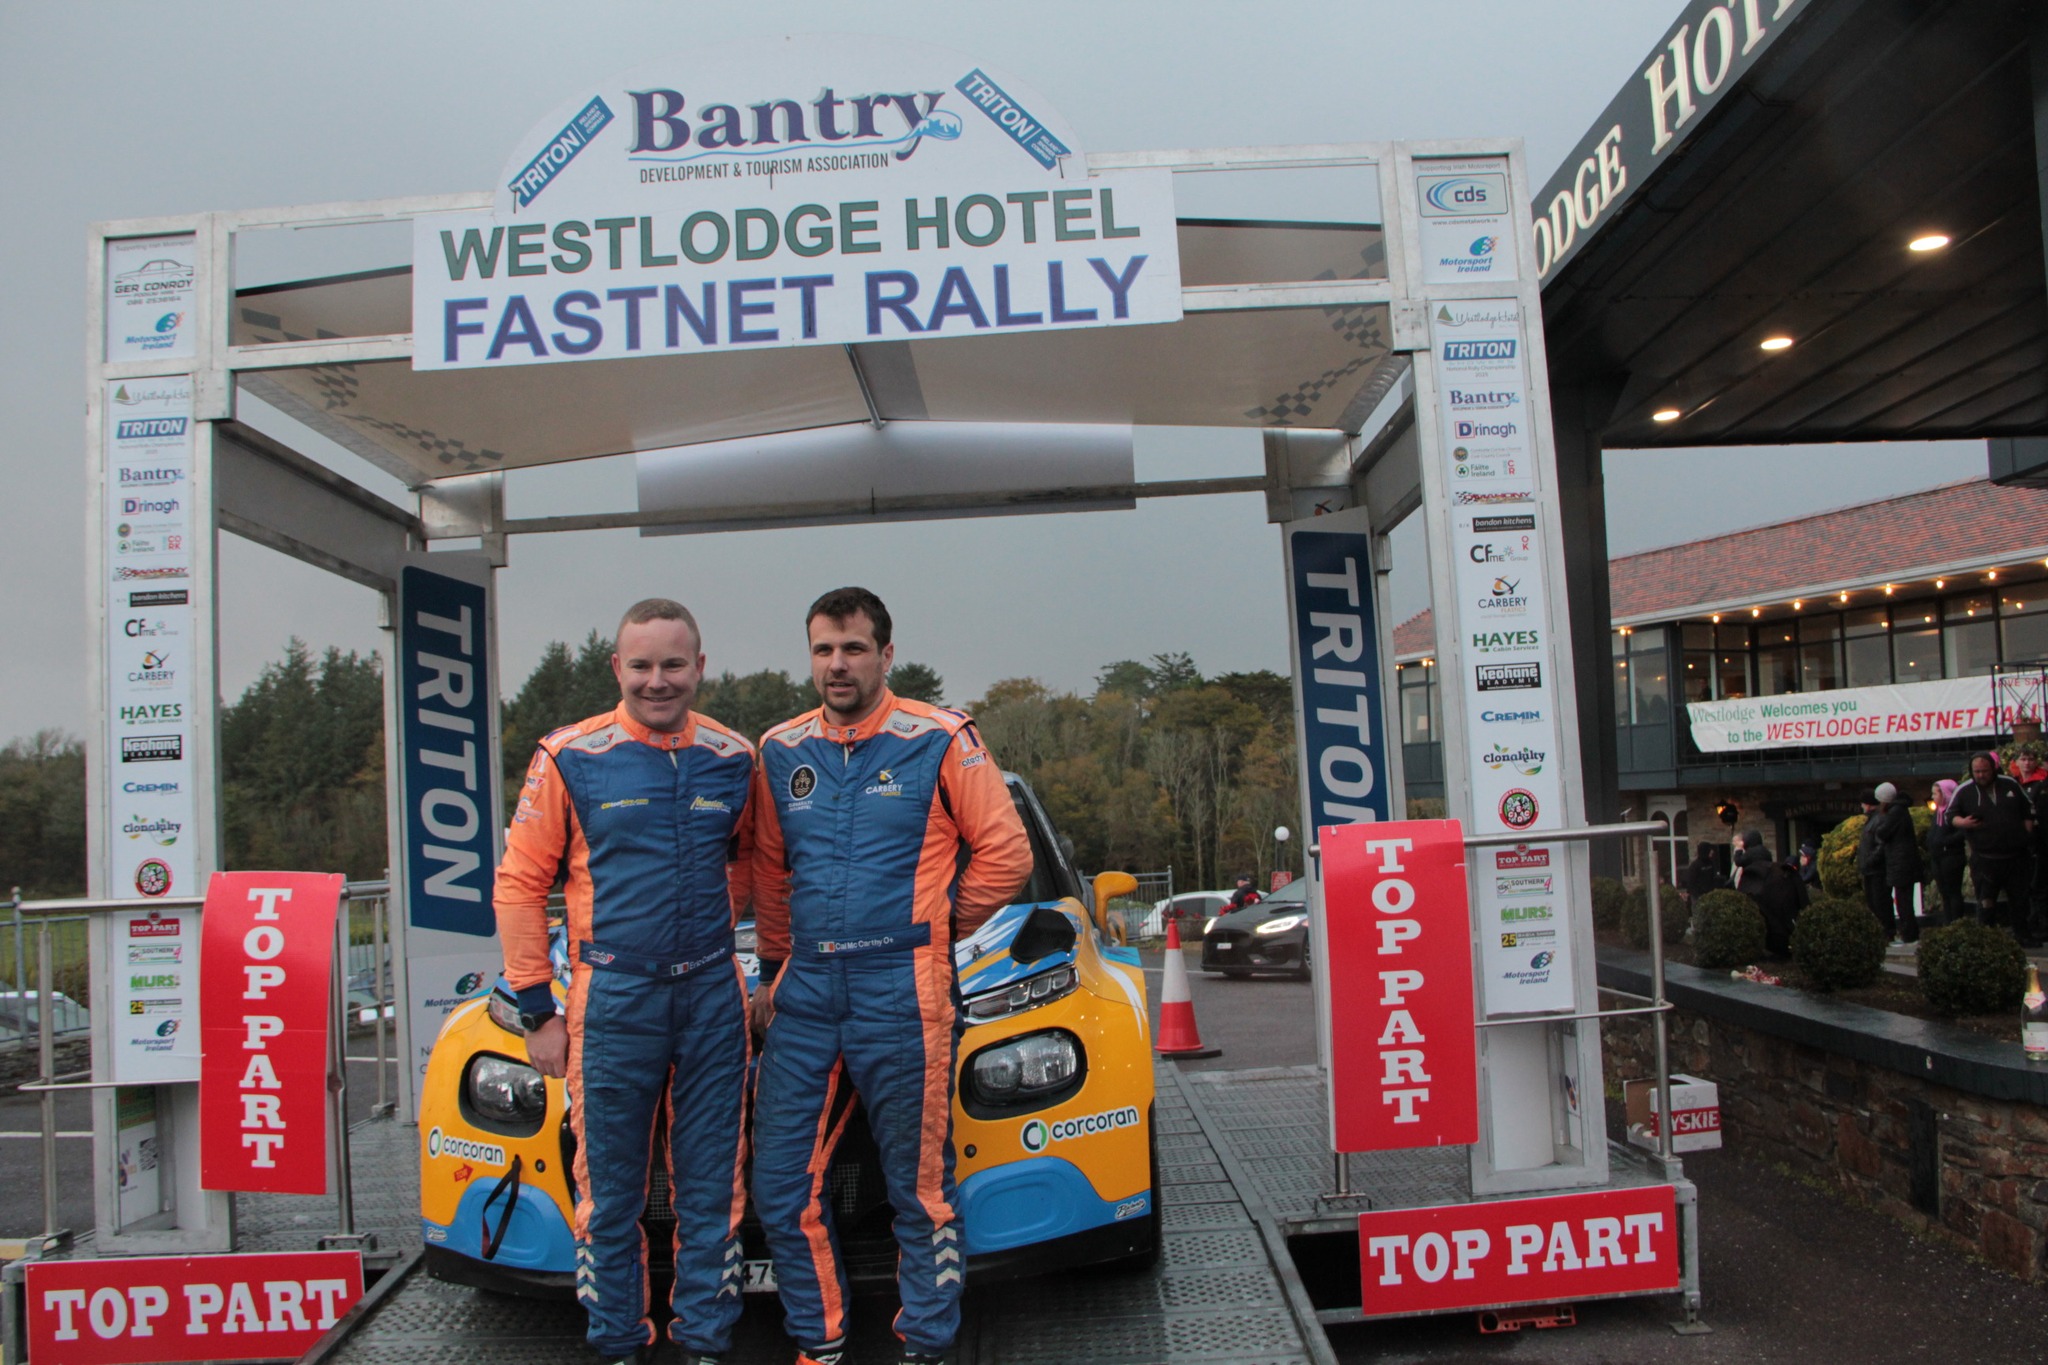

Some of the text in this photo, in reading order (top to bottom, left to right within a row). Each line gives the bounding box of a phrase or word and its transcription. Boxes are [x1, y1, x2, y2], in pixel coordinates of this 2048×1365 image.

[1644, 0, 1796, 155] HOT
[965, 74, 1035, 138] TRITON
[625, 87, 946, 161] Bantry
[512, 129, 581, 198] TRITON
[640, 153, 890, 183] DEVELOPMENT & TOURISM ASSOCIATION
[1455, 186, 1487, 203] cds
[440, 188, 1141, 281] WESTLODGE HOTEL
[1440, 257, 1493, 267] Motorsport
[1457, 264, 1491, 273] Ireland
[115, 279, 194, 294] GER CONROY
[442, 255, 1148, 362] FASTNET RALLY
[125, 333, 178, 344] Motorsport
[1447, 342, 1512, 358] TRITON
[1450, 390, 1516, 408] Bantry
[121, 418, 184, 437] TRITON
[1458, 421, 1517, 438] Drinagh
[118, 467, 182, 485] Bantry
[124, 499, 180, 514] Drinagh
[1478, 597, 1527, 609] CARBERY
[1473, 630, 1538, 647] HAYES
[128, 670, 176, 682] CARBERY
[1478, 664, 1538, 680] Keohane
[120, 703, 183, 720] HAYES
[1481, 711, 1540, 722] CREMIN
[1692, 700, 1857, 724] Westlodge Welcomes you
[1728, 703, 2048, 743] to the WESTLODGE FASTNET RALL
[416, 605, 482, 903] TRITON
[123, 782, 179, 793] CREMIN
[866, 784, 903, 794] CARBERY
[1521, 855, 1548, 863] PART
[131, 924, 178, 933] TOP PART
[1502, 934, 1516, 946] 25
[1365, 838, 1431, 1124] TOP PART
[1502, 970, 1550, 979] Motorsport
[1519, 976, 1549, 985] Ireland
[130, 1001, 145, 1013] 25
[424, 998, 471, 1009] Motorsp
[239, 888, 293, 1168] TOP PART
[1052, 1108, 1138, 1139] corcoran
[444, 1137, 504, 1164] corcoran
[1368, 1212, 1663, 1286] TOP PART
[44, 1278, 347, 1341] TOP PART
